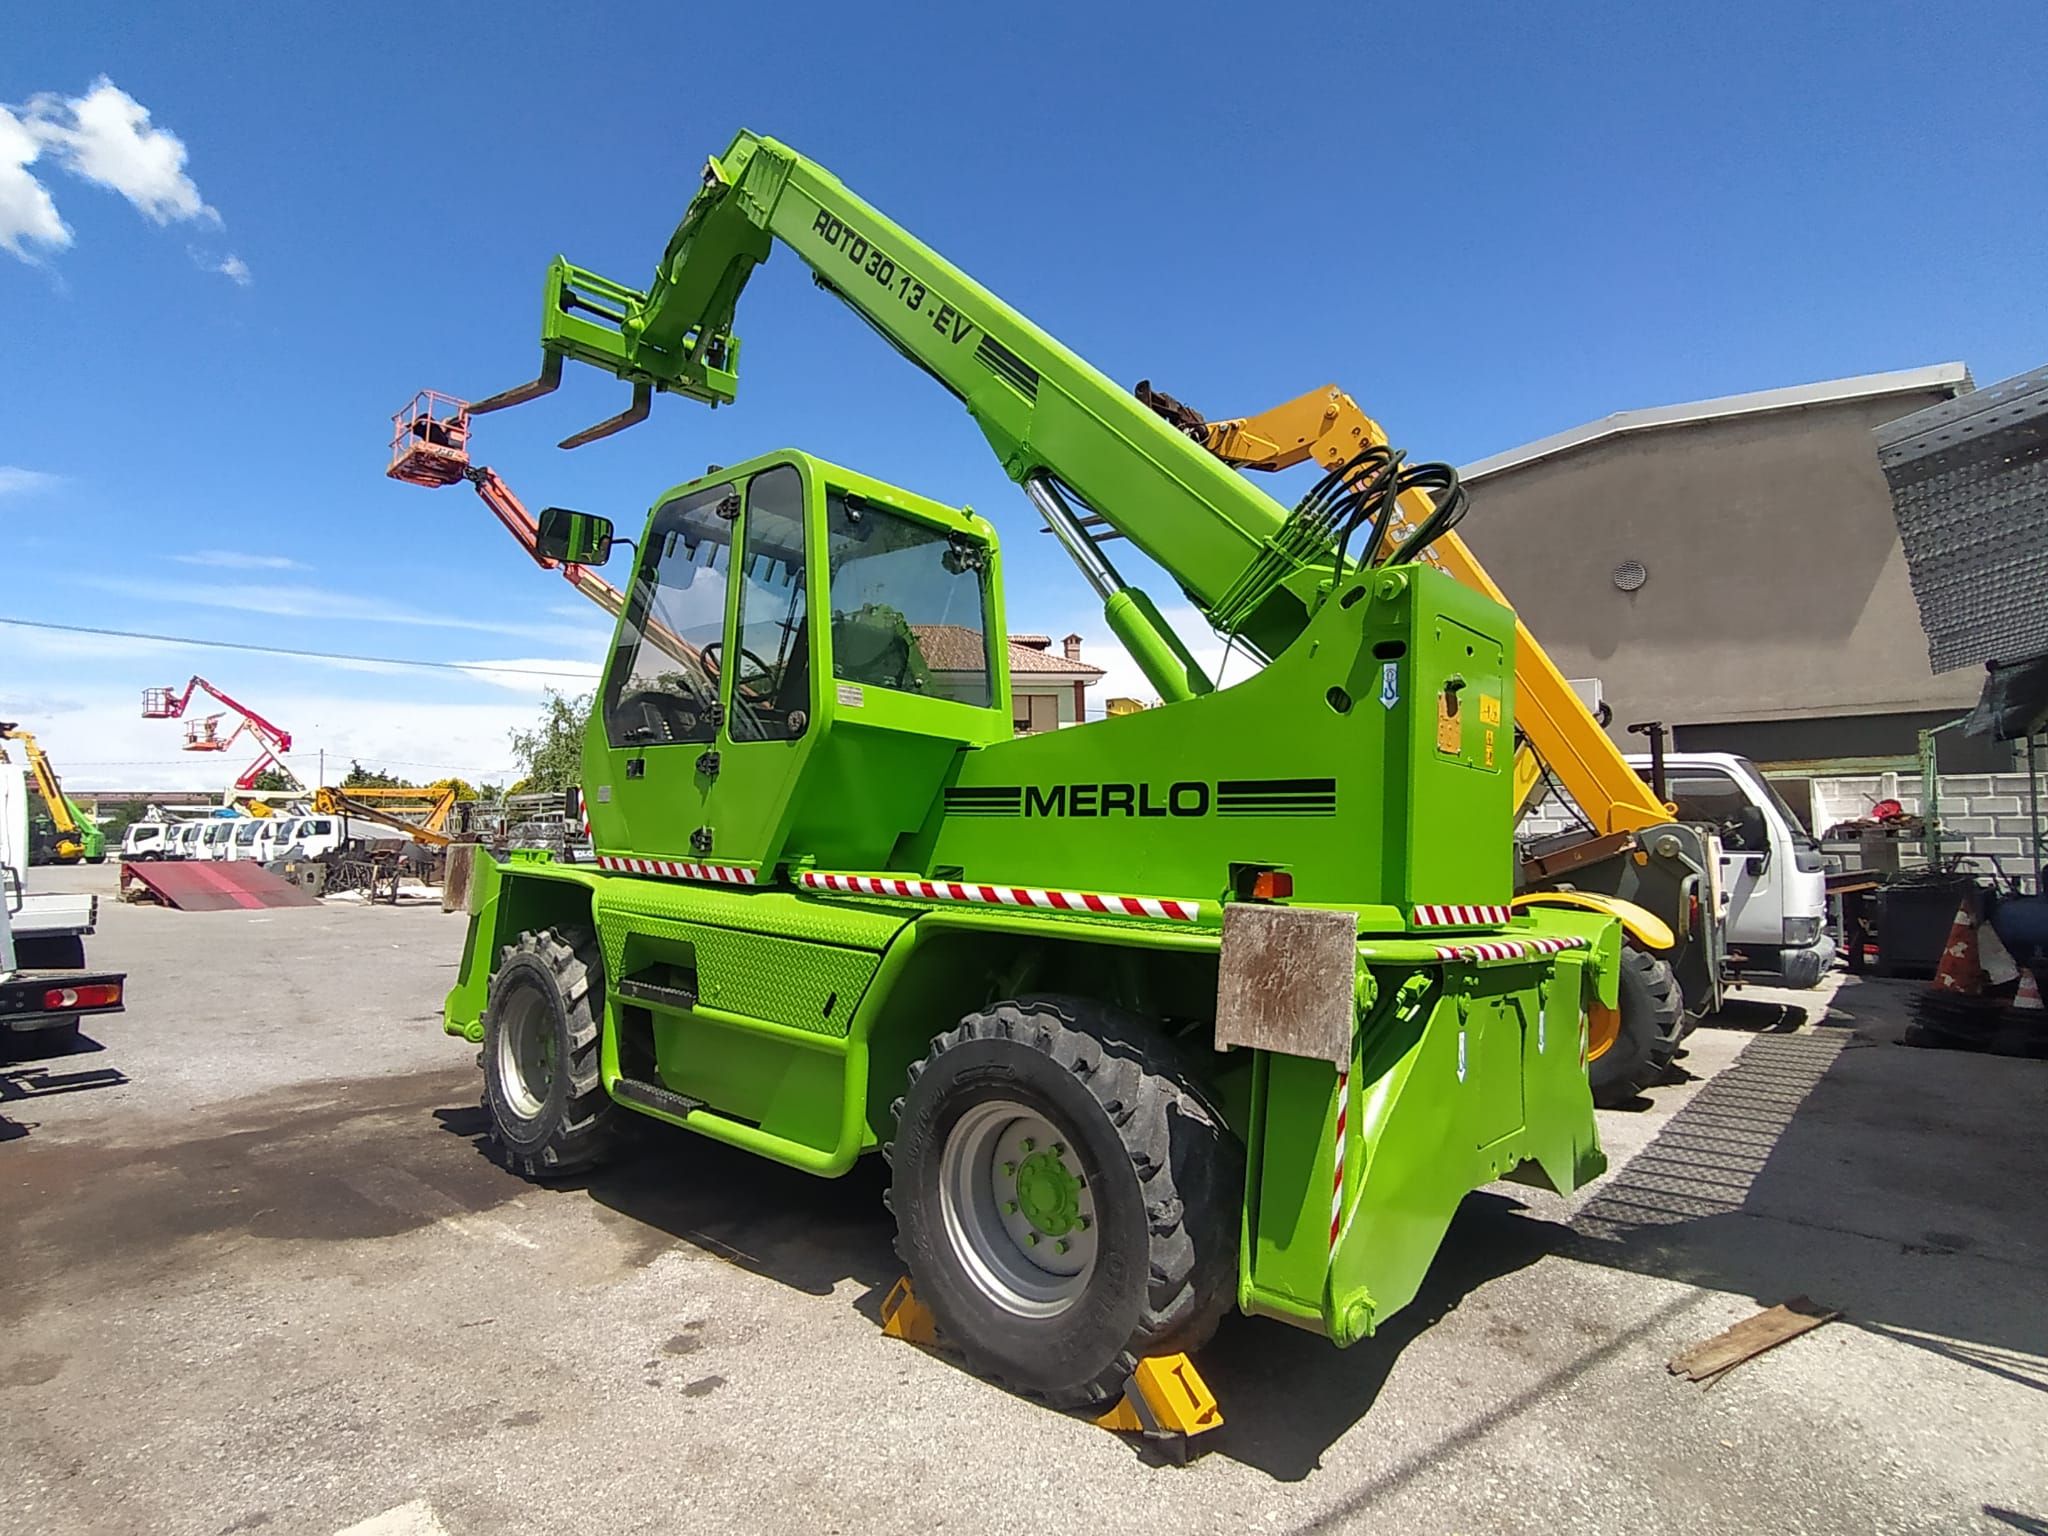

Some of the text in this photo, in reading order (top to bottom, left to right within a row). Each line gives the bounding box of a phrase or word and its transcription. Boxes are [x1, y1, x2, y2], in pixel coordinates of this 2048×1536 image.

[812, 209, 868, 265] ROTO
[864, 251, 926, 311] 30.13
[1025, 781, 1210, 817] MERLO
